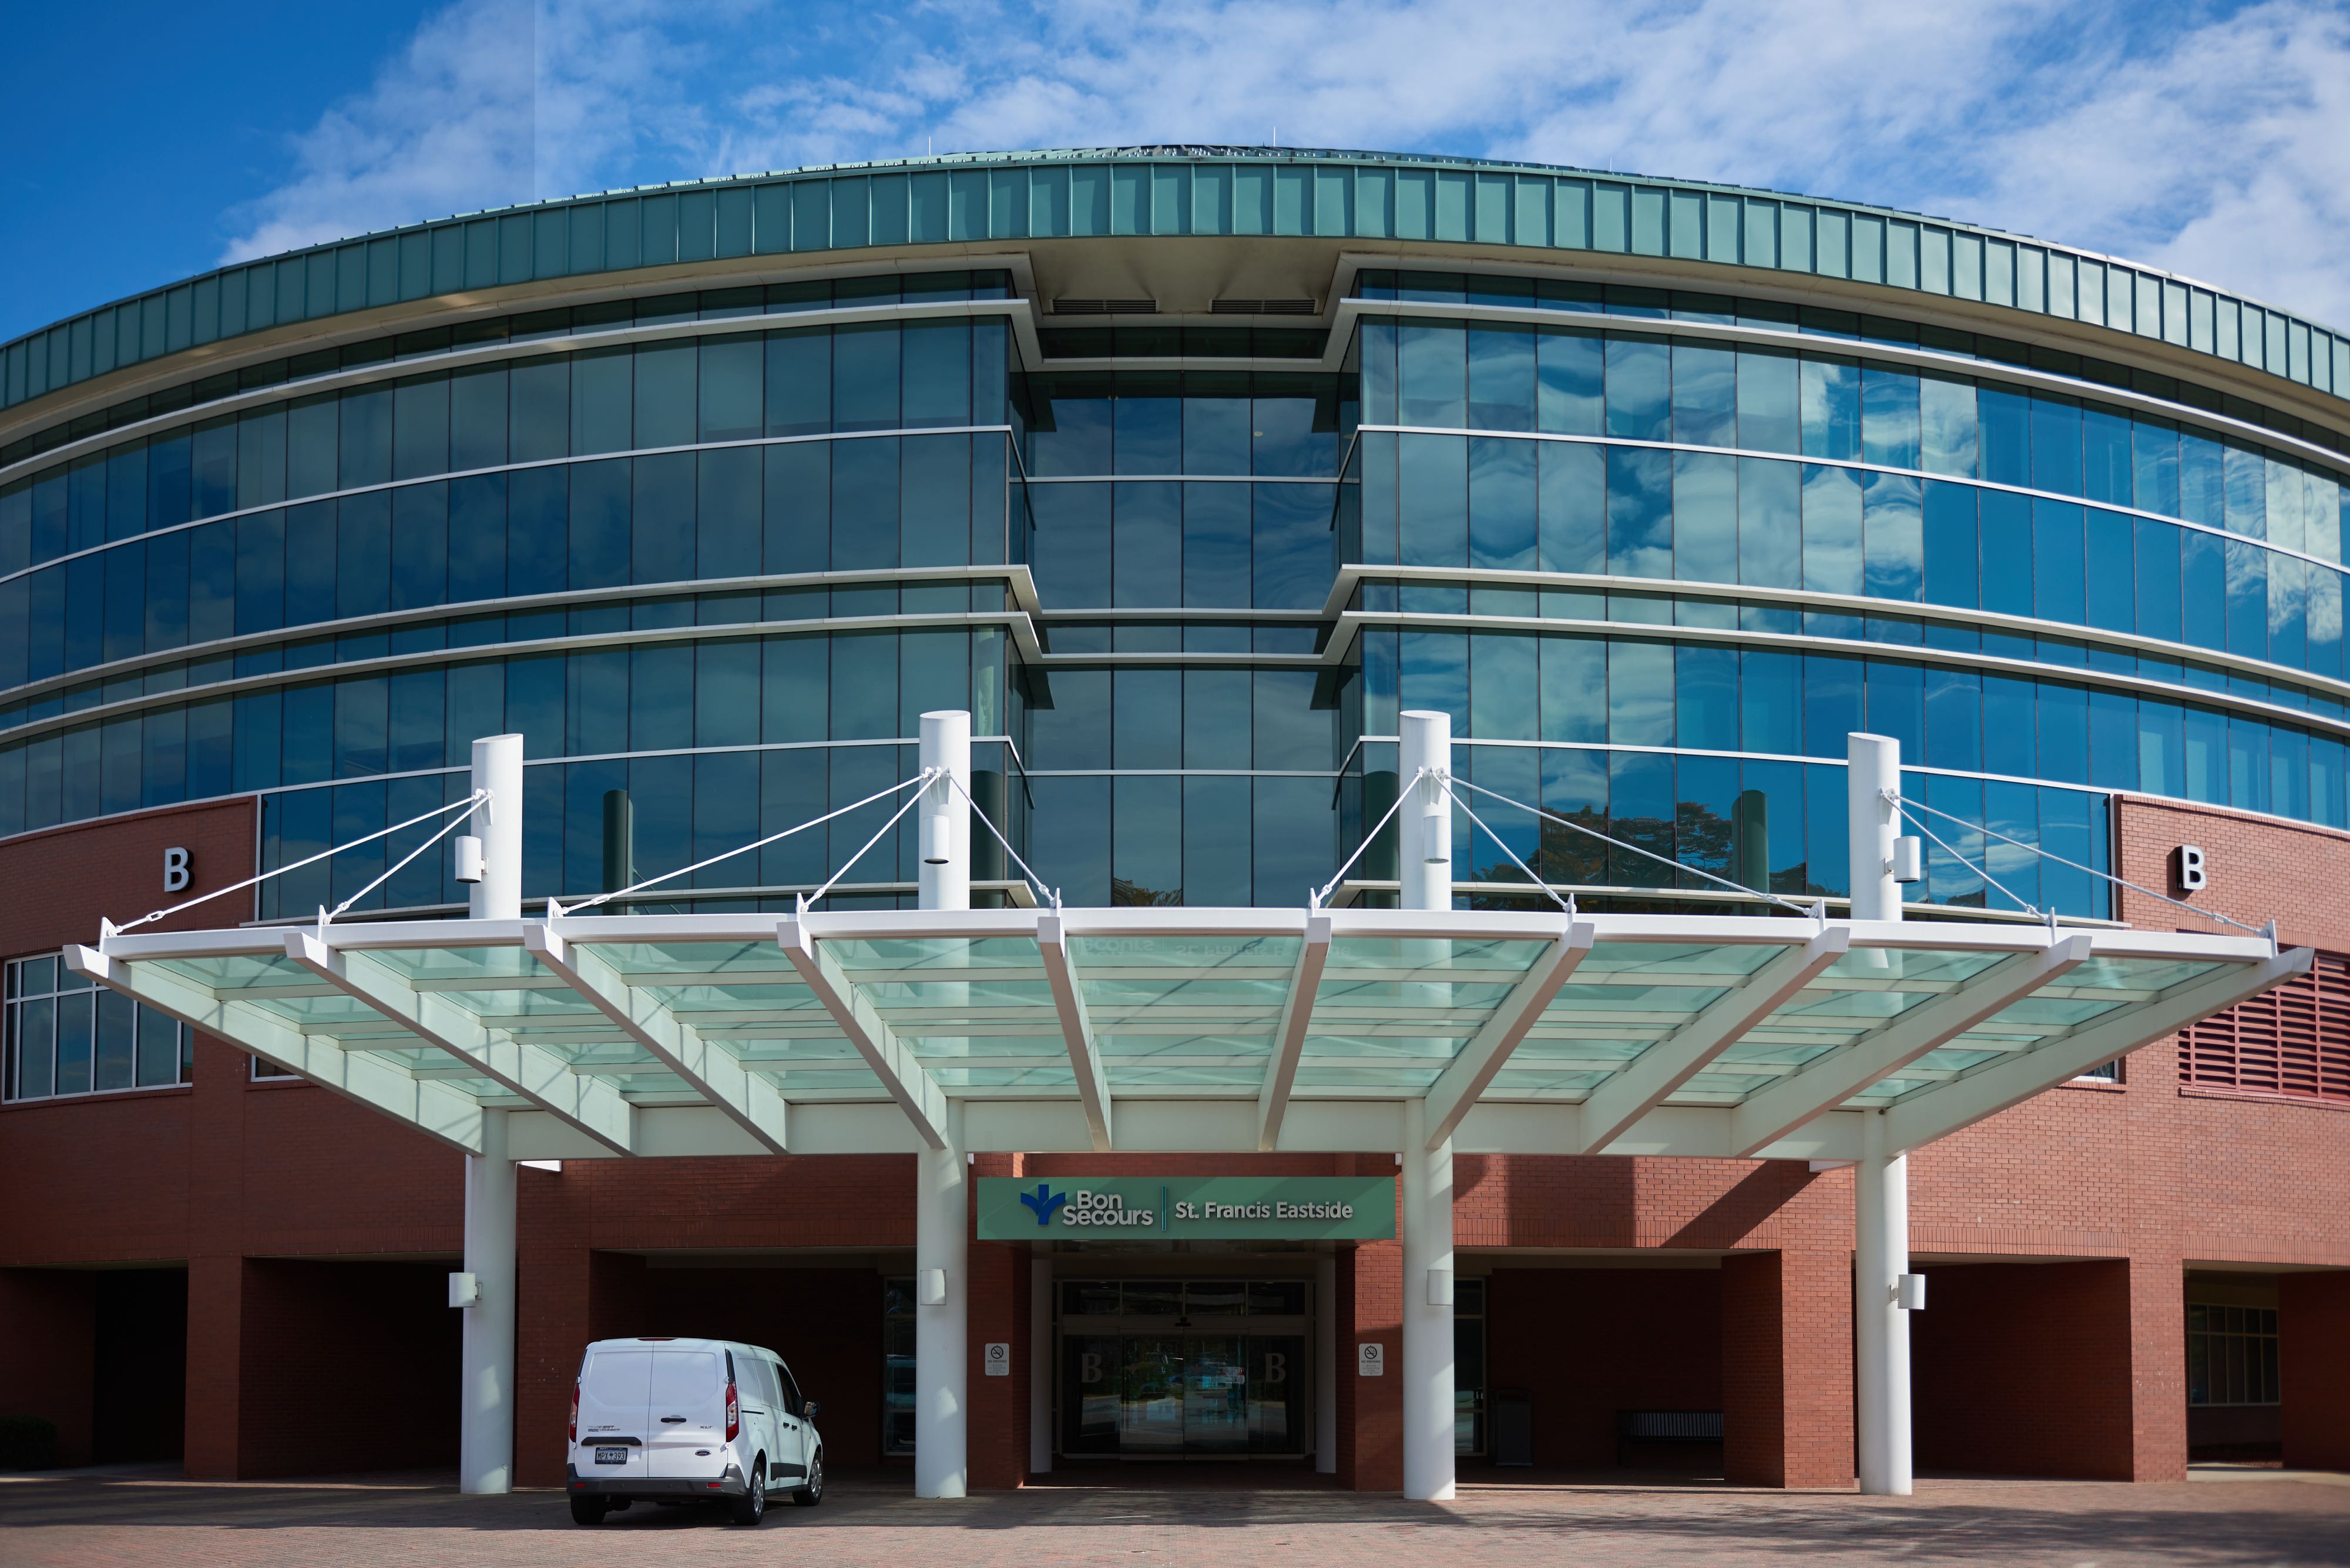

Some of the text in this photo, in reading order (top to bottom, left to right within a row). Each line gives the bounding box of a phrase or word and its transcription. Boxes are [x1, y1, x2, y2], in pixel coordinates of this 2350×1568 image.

[164, 847, 189, 892] B
[2181, 845, 2206, 890] B
[1077, 1190, 1122, 1209] Bon
[1175, 1201, 1353, 1218] St. Francis Eastside
[1062, 1205, 1153, 1225] Secours
[1082, 1353, 1102, 1382] B
[1265, 1353, 1286, 1382] B
[597, 1452, 625, 1460] MPX 393
